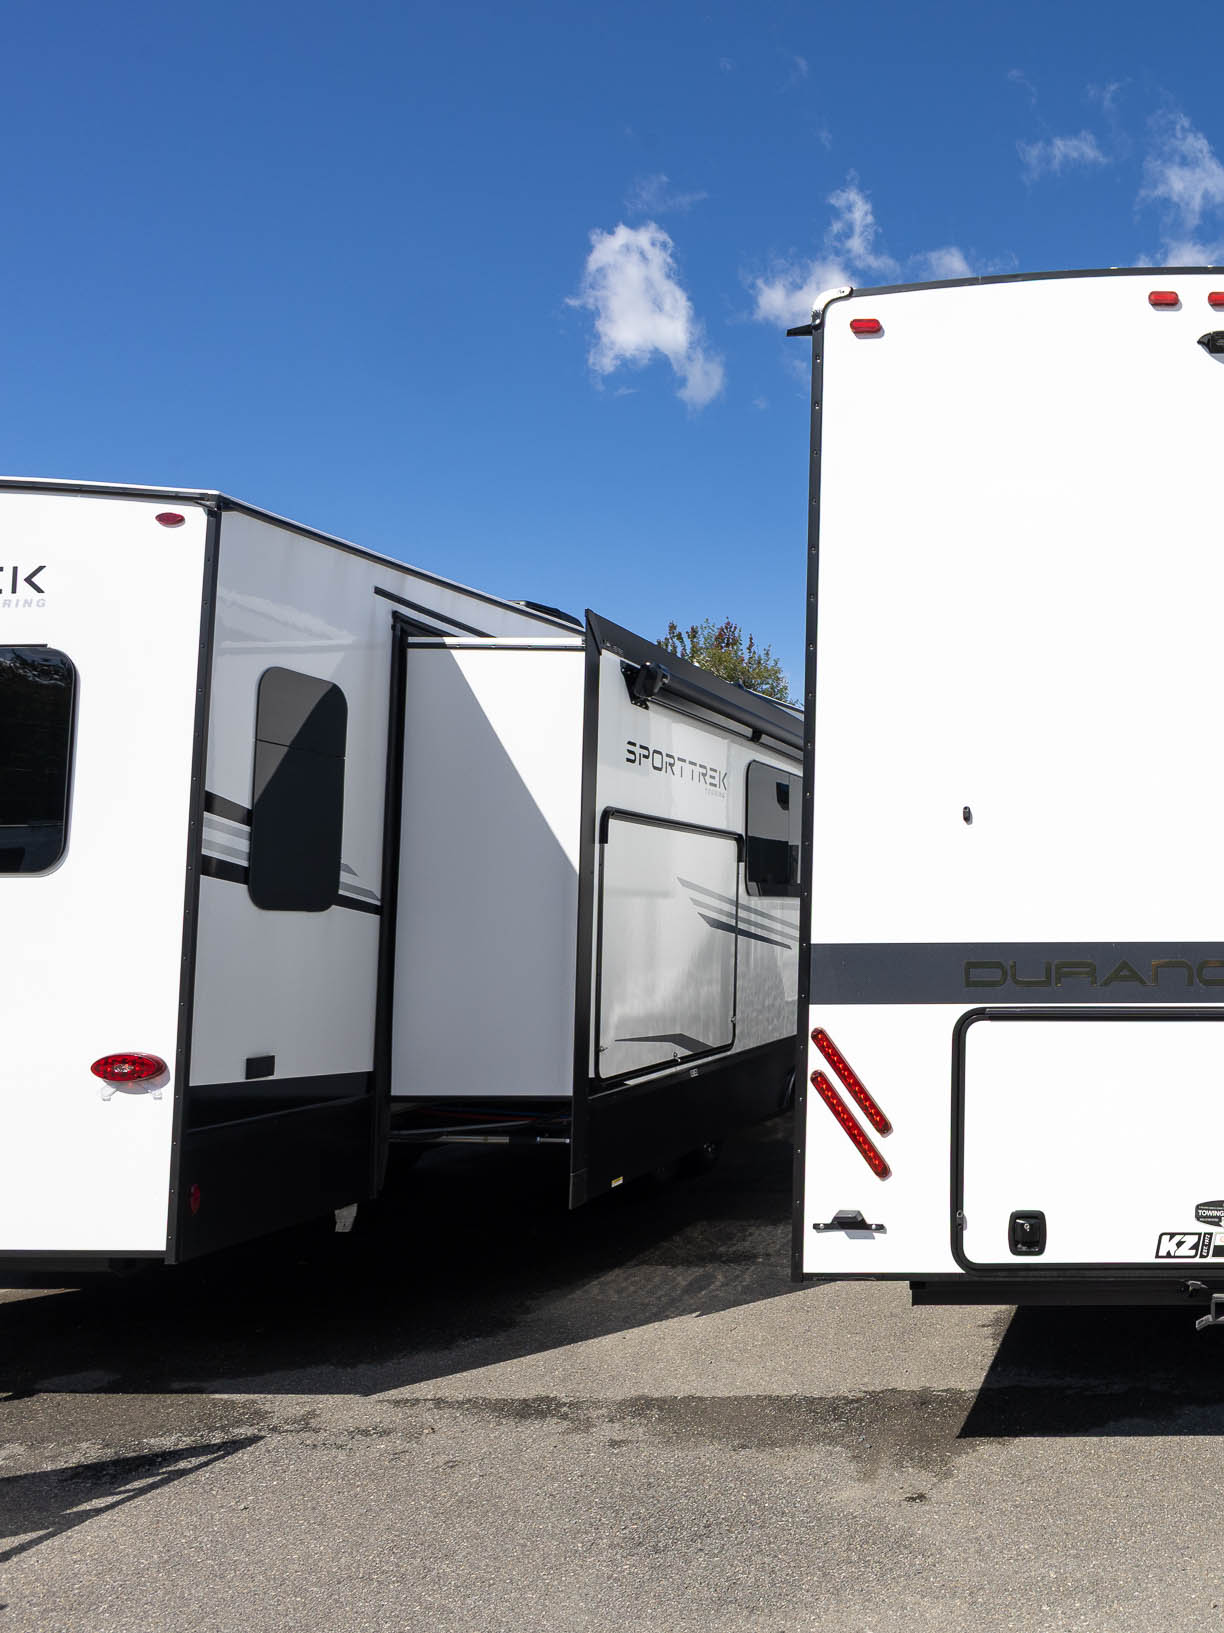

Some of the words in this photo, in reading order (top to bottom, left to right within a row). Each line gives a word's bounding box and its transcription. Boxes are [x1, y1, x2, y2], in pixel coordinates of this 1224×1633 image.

[0, 565, 46, 594] K
[625, 740, 727, 790] SPORTTREK
[1158, 1234, 1199, 1256] KZ
